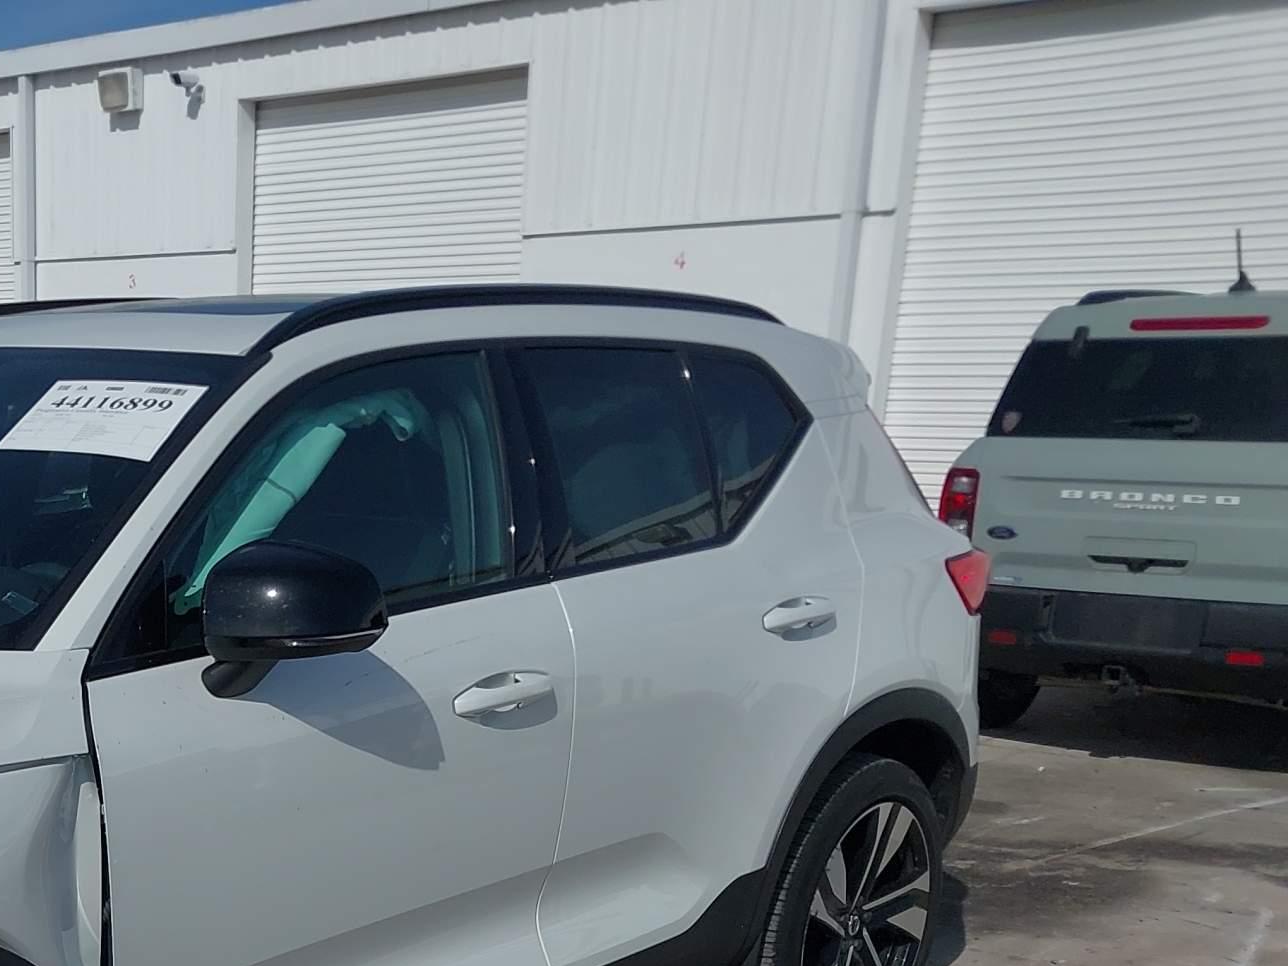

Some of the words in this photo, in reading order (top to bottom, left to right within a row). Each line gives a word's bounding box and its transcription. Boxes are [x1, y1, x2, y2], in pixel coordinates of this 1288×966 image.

[673, 251, 687, 270] 4
[128, 273, 137, 290] 3
[51, 395, 173, 411] 44116899
[1060, 489, 1241, 505] BRONCO
[1113, 502, 1177, 511] SPORT
